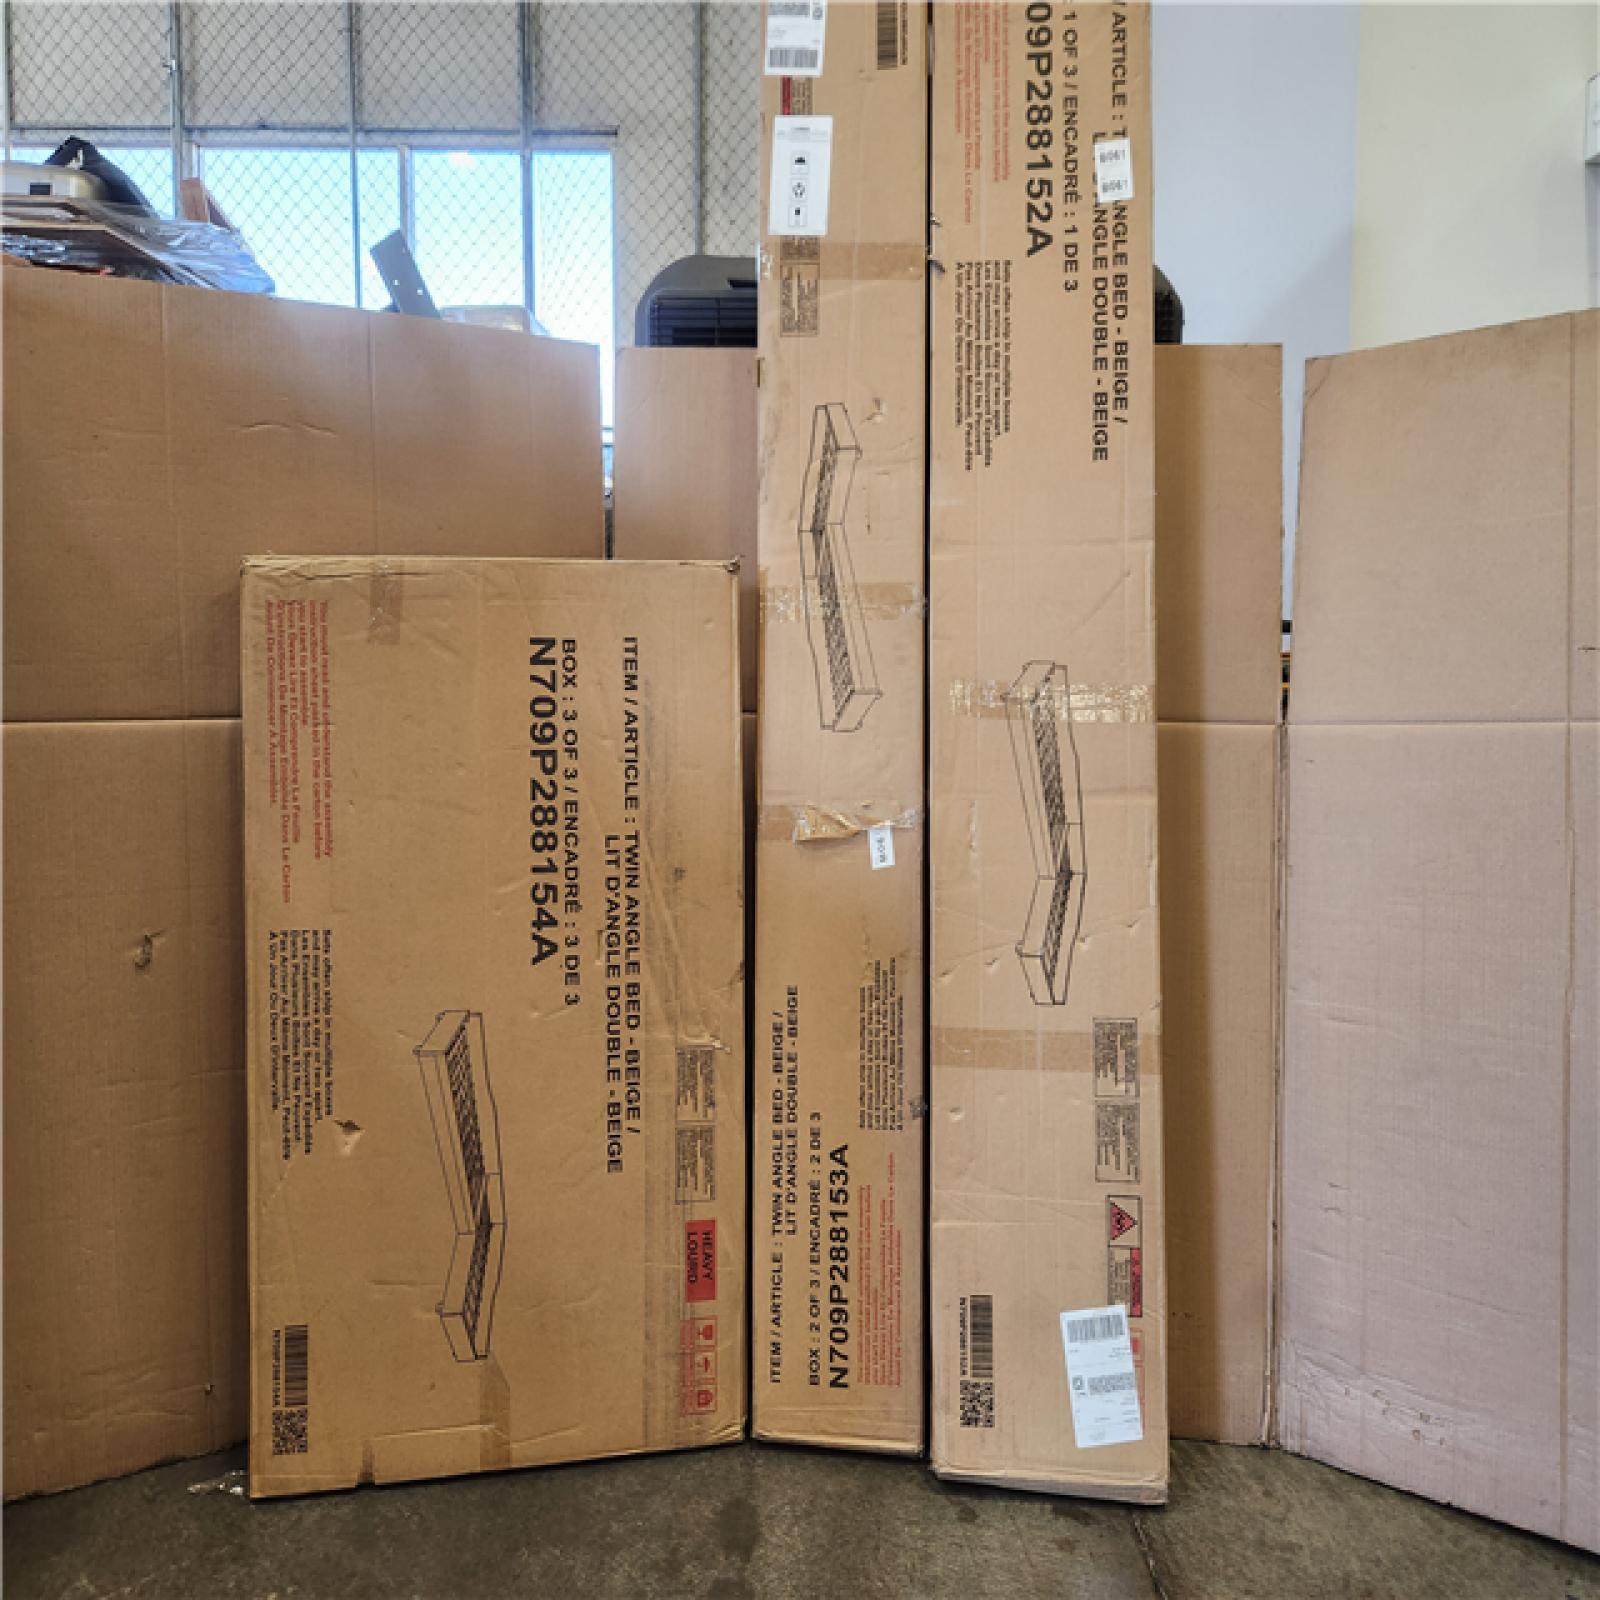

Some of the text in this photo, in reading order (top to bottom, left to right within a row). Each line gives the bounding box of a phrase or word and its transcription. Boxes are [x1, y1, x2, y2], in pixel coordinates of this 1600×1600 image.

[1063, 10, 1077, 20] 1
[1063, 28, 1078, 58] OF
[1112, 11, 1127, 108] ARTICLE
[1063, 65, 1078, 78] 3
[1063, 95, 1079, 205] ENCADRÉ
[1064, 225, 1078, 235] 1
[1064, 242, 1078, 273] DE
[1064, 280, 1078, 293] 3
[1112, 273, 1128, 320] BED
[1092, 277, 1108, 371] DOUBLE
[1113, 340, 1128, 411] BEIGE
[1092, 392, 1108, 461] BEIGE
[562, 639, 578, 688] BOX
[623, 637, 638, 691] ITEM
[562, 709, 578, 722] 3
[563, 729, 578, 760] OF
[624, 709, 639, 810] ARTICLE
[563, 768, 578, 780] 3
[530, 637, 558, 967] N709P288154A
[564, 800, 581, 914] ENCADRÉ
[605, 835, 620, 869] LIT
[625, 830, 640, 888] TWIN
[564, 935, 580, 948] 3
[605, 876, 621, 979] D'ANGLE
[625, 895, 640, 975] ANGLE
[565, 955, 580, 986] DE
[565, 993, 580, 1006] 3
[625, 982, 640, 1030] BED
[787, 986, 798, 1038] BEIGE
[606, 985, 621, 1083] DOUBLE
[772, 1022, 783, 1073] BEIGE
[625, 1049, 640, 1120] BEIGE
[772, 1089, 783, 1125] BED
[787, 1052, 798, 1123] DOUBLE
[607, 1102, 622, 1173] BEIGE
[810, 1112, 821, 1121] 3
[810, 1127, 821, 1150] DE
[772, 1130, 783, 1190] ANGLE
[785, 1128, 797, 1204] D'ANGLE
[810, 1154, 821, 1165] 2
[772, 1193, 783, 1236] TWIN
[785, 1209, 797, 1235] LIT
[809, 1180, 820, 1265] ENCADRÉ
[687, 1231, 698, 1284] LOURD
[702, 1231, 713, 1281] HEAVY
[829, 1144, 848, 1388] N709P288153A
[770, 1252, 783, 1328] ARTICLE
[809, 1279, 820, 1288] 3
[809, 1294, 821, 1318] OF
[809, 1322, 821, 1333] 2
[770, 1341, 781, 1383] ITEM
[809, 1348, 820, 1386] BOX
